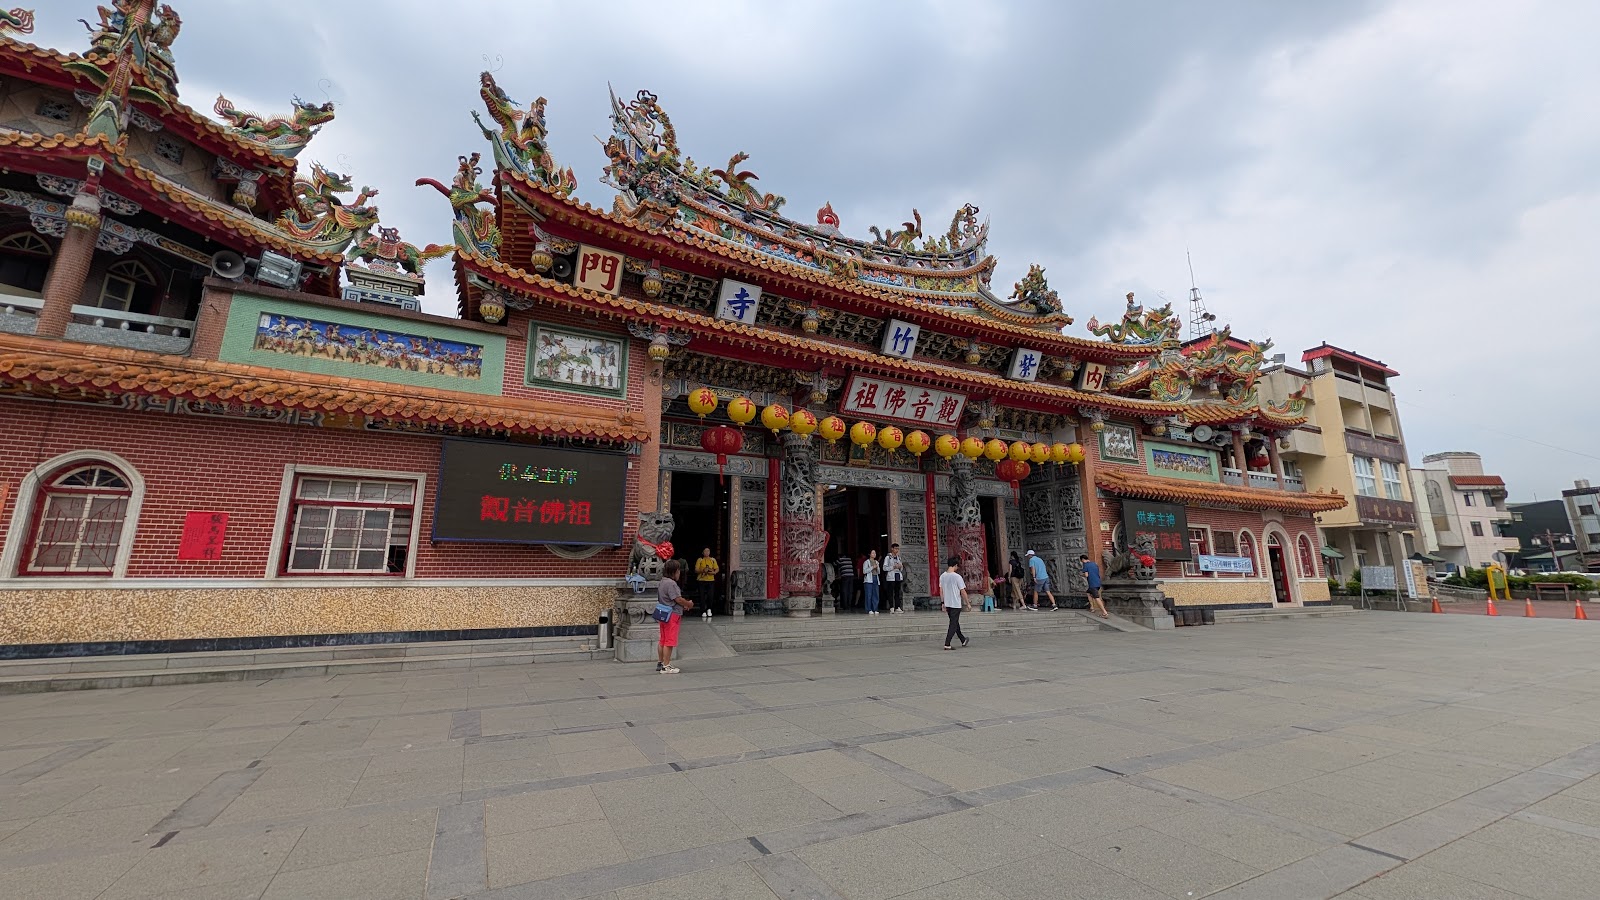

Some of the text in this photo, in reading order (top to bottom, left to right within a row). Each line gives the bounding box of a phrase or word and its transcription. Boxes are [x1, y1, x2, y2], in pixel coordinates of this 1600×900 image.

[580, 252, 620, 291] 門
[727, 287, 755, 320] 寺
[892, 326, 914, 355] 竹
[1018, 353, 1037, 377] 紫
[480, 494, 592, 526] 觀音佛祖
[1136, 531, 1183, 551] 佛祖
